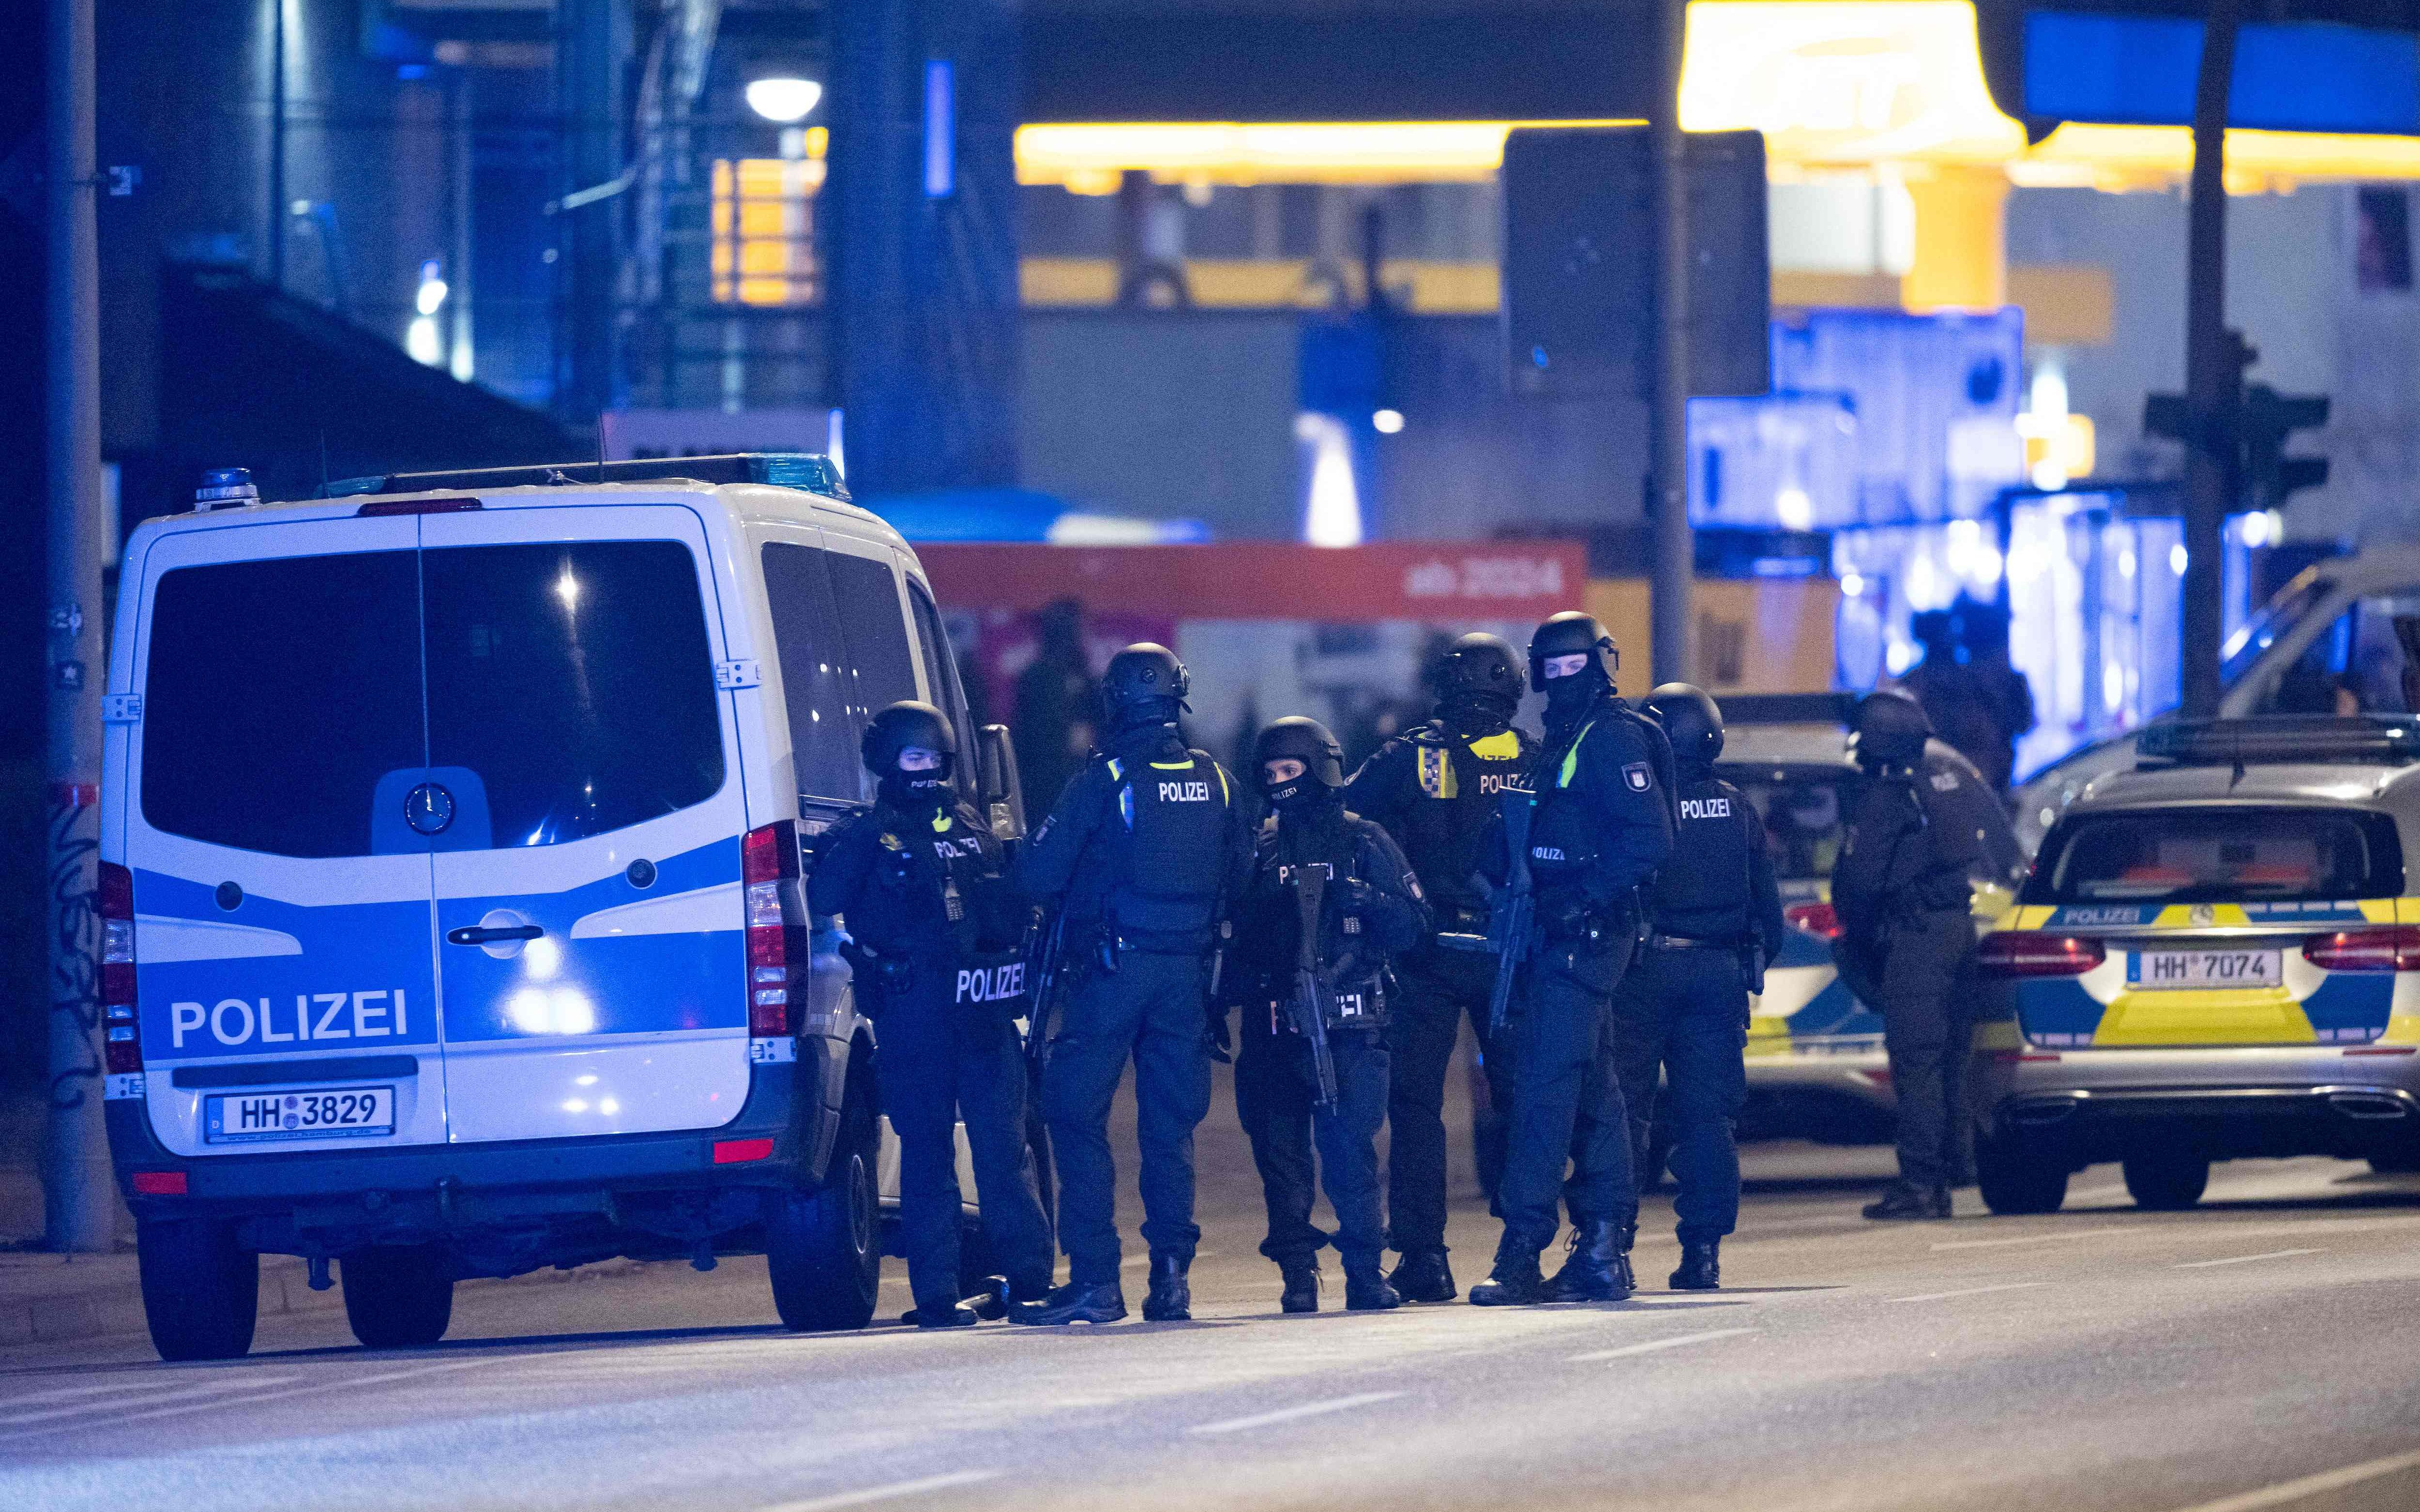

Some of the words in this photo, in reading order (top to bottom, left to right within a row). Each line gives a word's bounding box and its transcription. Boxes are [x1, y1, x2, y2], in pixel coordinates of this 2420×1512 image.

[1159, 782, 1209, 801] POLIZEI
[1480, 773, 1533, 794] POLIZ
[1680, 799, 1730, 819] POLIZEI
[2064, 907, 2140, 925] POLIZEI
[2154, 956, 2187, 978] HH
[2205, 954, 2265, 978] 7074
[956, 962, 1025, 1003] POLIZEI
[171, 989, 407, 1048] POLIZEI
[242, 1098, 280, 1129] HH
[302, 1094, 377, 1126] 3829
